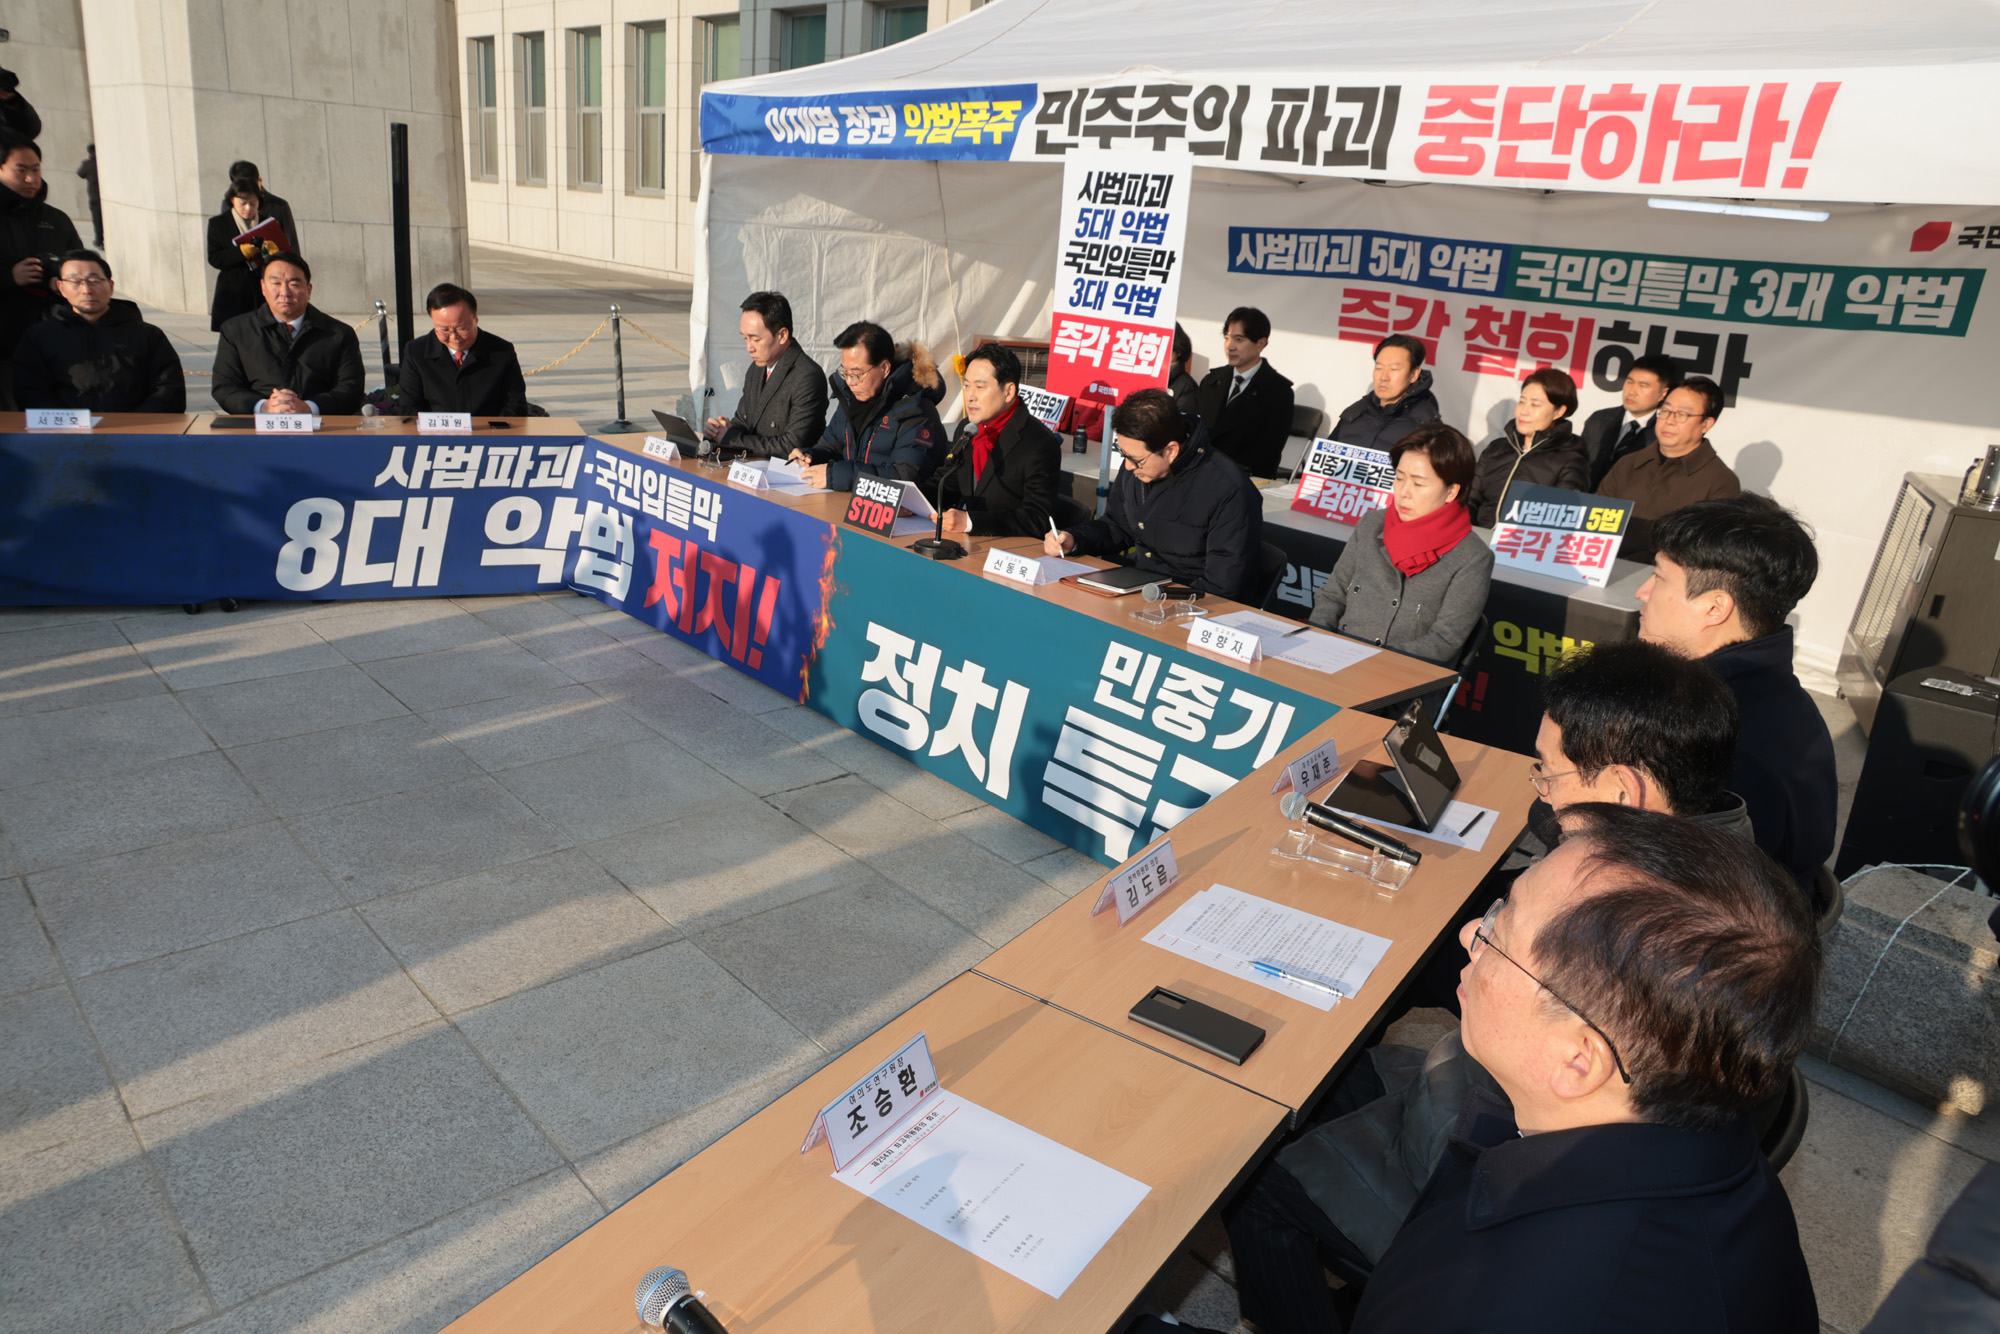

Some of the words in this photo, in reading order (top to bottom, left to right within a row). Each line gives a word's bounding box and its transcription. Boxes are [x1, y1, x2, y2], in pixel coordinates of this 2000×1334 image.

[765, 106, 839, 145] 이재명
[840, 104, 897, 145] 정권
[903, 100, 1022, 144] 악법폭주
[1035, 84, 1250, 161] 민주주의
[1260, 84, 1402, 171] 파괴
[1413, 81, 1842, 189] 중단하라!
[1077, 170, 1174, 208] 사법파괴
[1075, 207, 1116, 240] 5대
[1119, 210, 1170, 245] 악법
[1064, 240, 1176, 284] 국민입틀막
[1236, 232, 1363, 275] 사법파괴
[1368, 237, 1422, 282] 5대
[1429, 244, 1502, 292] 악법
[1516, 251, 1738, 315] 국민입틀막
[1743, 269, 1834, 322] 3대
[1844, 274, 1965, 328] 악법
[1069, 277, 1109, 311] 3대
[1112, 282, 1162, 318] 악법
[1053, 319, 1110, 368] 즉각
[1108, 328, 1170, 378] 철회
[1338, 287, 1451, 367] 즉각
[856, 477, 901, 507] 정치보복
[1310, 453, 1353, 480] 민중기
[1352, 461, 1396, 490] 특검을
[848, 496, 895, 530] STOP
[1504, 500, 1587, 529] 사법파괴
[1586, 507, 1625, 533] 5법
[1495, 527, 1552, 562] 즉각
[1553, 533, 1613, 569] 철회
[275, 496, 454, 592] 8대
[480, 496, 635, 602] 악법
[643, 527, 781, 670] 저지!
[1200, 629, 1244, 655] 양향자
[858, 621, 1030, 800] 정치
[1094, 640, 1296, 769] 민중기
[1126, 864, 1167, 909] 김도읍
[847, 1064, 918, 1140] 조승환
[849, 1056, 905, 1105] 여의도연구원장
